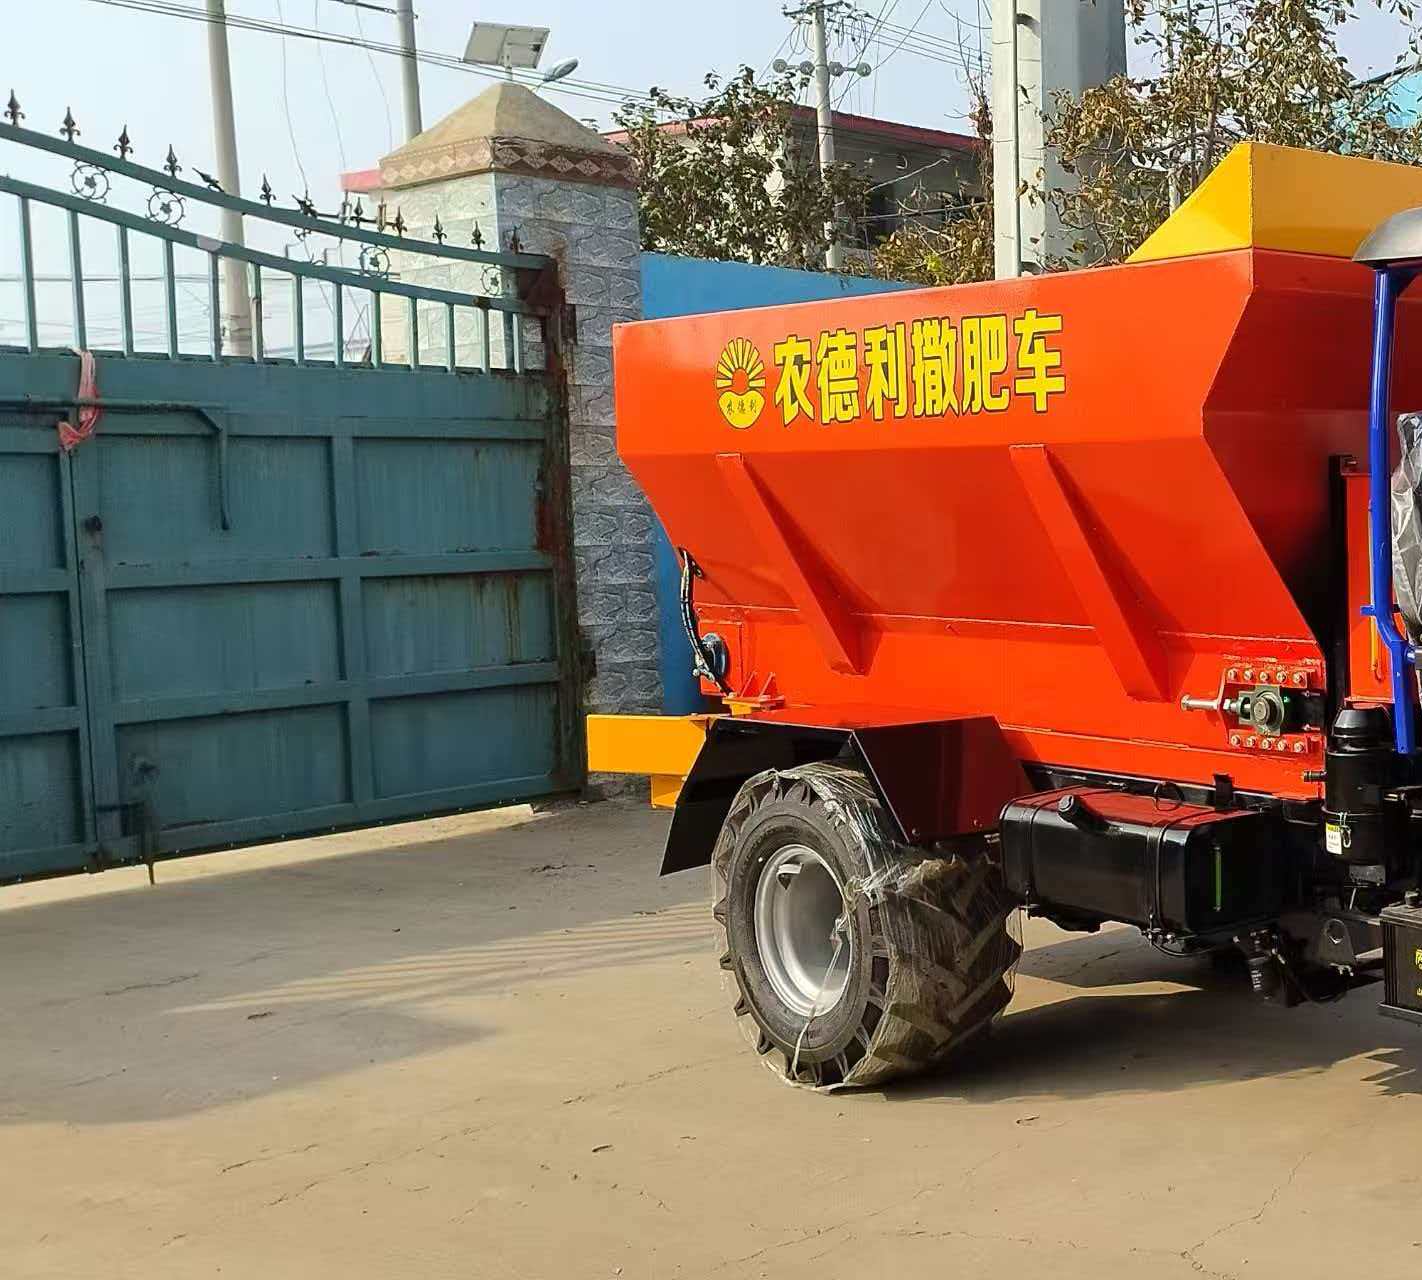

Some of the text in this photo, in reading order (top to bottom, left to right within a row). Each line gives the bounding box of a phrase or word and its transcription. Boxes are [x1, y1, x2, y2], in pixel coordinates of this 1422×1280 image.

[773, 308, 1066, 426] 农德利撒肥车
